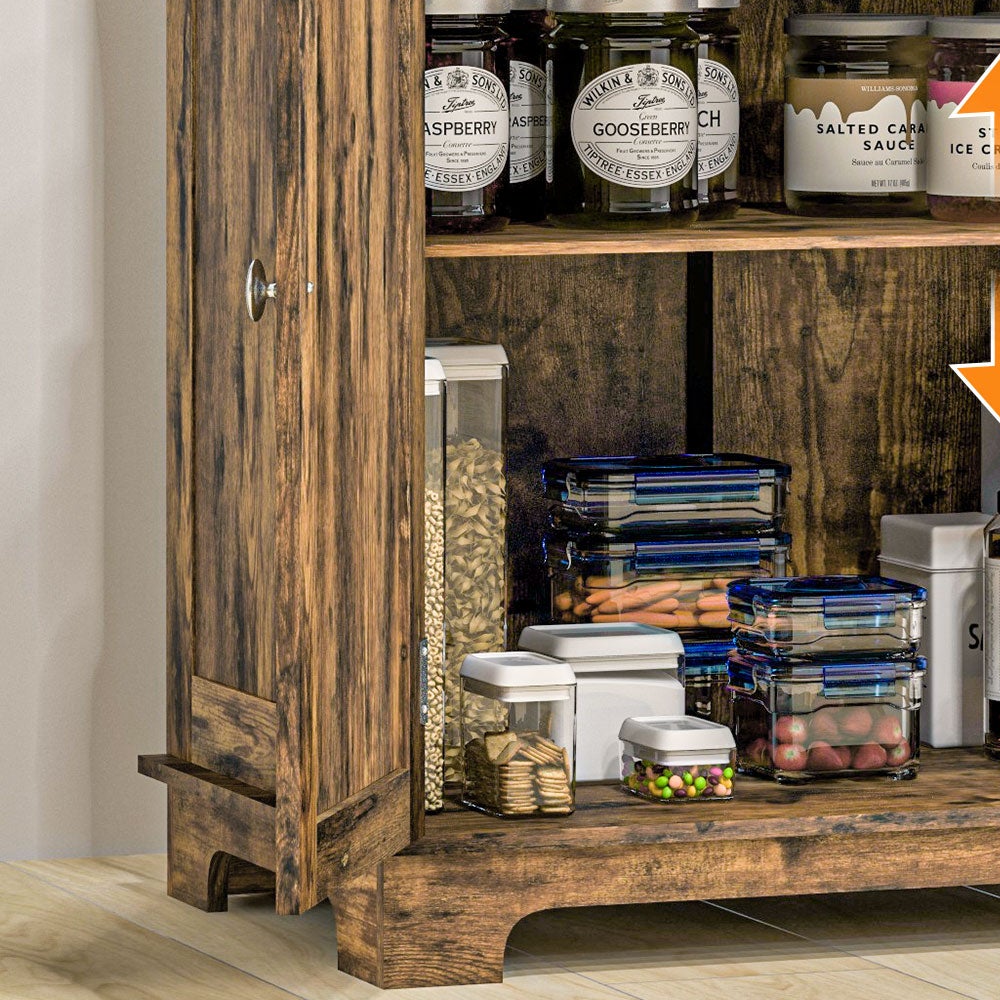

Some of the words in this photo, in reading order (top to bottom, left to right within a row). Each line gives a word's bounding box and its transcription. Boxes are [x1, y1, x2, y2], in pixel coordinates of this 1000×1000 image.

[704, 66, 728, 85] SONS
[471, 75, 496, 94] SONS
[582, 76, 621, 107] WILKIN
[624, 73, 633, 83] &
[662, 72, 686, 94] SONS
[592, 121, 690, 137] GOOSEBERRY
[817, 124, 879, 134] SALTED
[887, 123, 927, 134] CARA
[863, 140, 915, 151] SAUCE
[950, 143, 973, 154] ICE
[583, 144, 622, 176] TIPTREE
[625, 168, 662, 180] ESSEX
[435, 173, 472, 184] ESSEX
